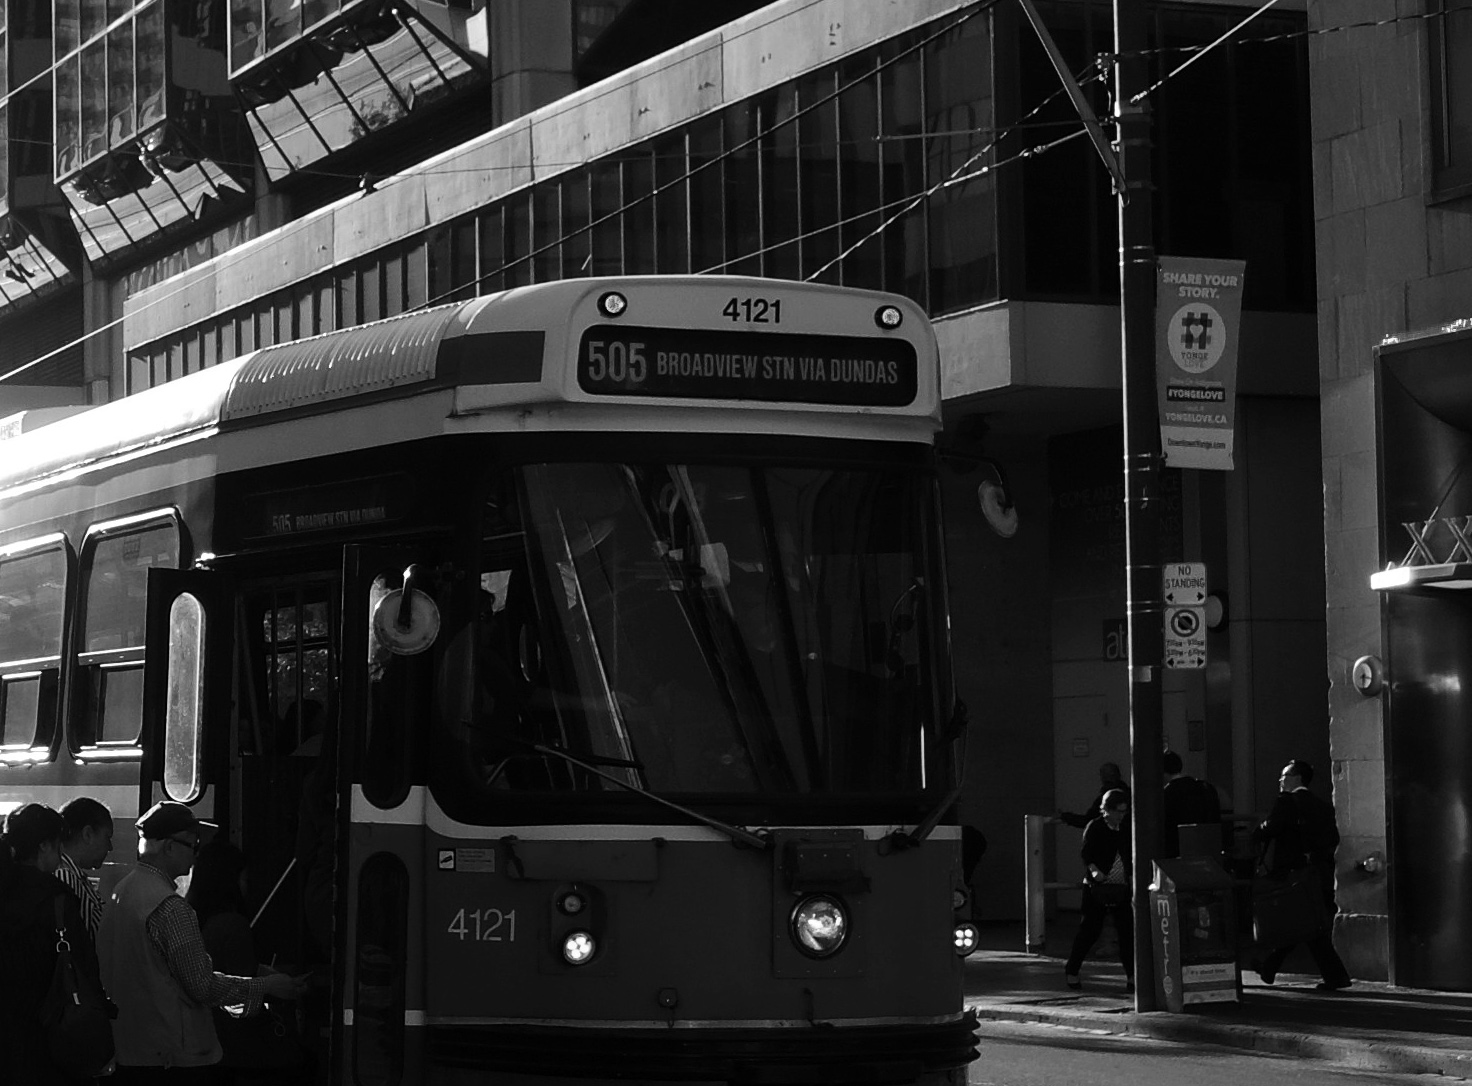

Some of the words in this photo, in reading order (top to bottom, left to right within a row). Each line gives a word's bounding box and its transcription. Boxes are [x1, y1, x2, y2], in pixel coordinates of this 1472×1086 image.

[1163, 272, 1202, 285] SHARE
[1203, 274, 1238, 287] YOUR
[1178, 285, 1220, 299] STORY.
[722, 298, 781, 324] 4121
[588, 340, 647, 383] 505
[657, 351, 758, 379] BROADVIEW
[762, 356, 795, 381] STN
[799, 357, 826, 382] VIA
[830, 359, 898, 385] DUNDAS
[1165, 412, 1227, 424] YONGELOVE.CA
[272, 513, 292, 533] 505
[1178, 565, 1192, 576] NO
[1165, 577, 1205, 589] STANDING
[447, 907, 516, 942] 4121
